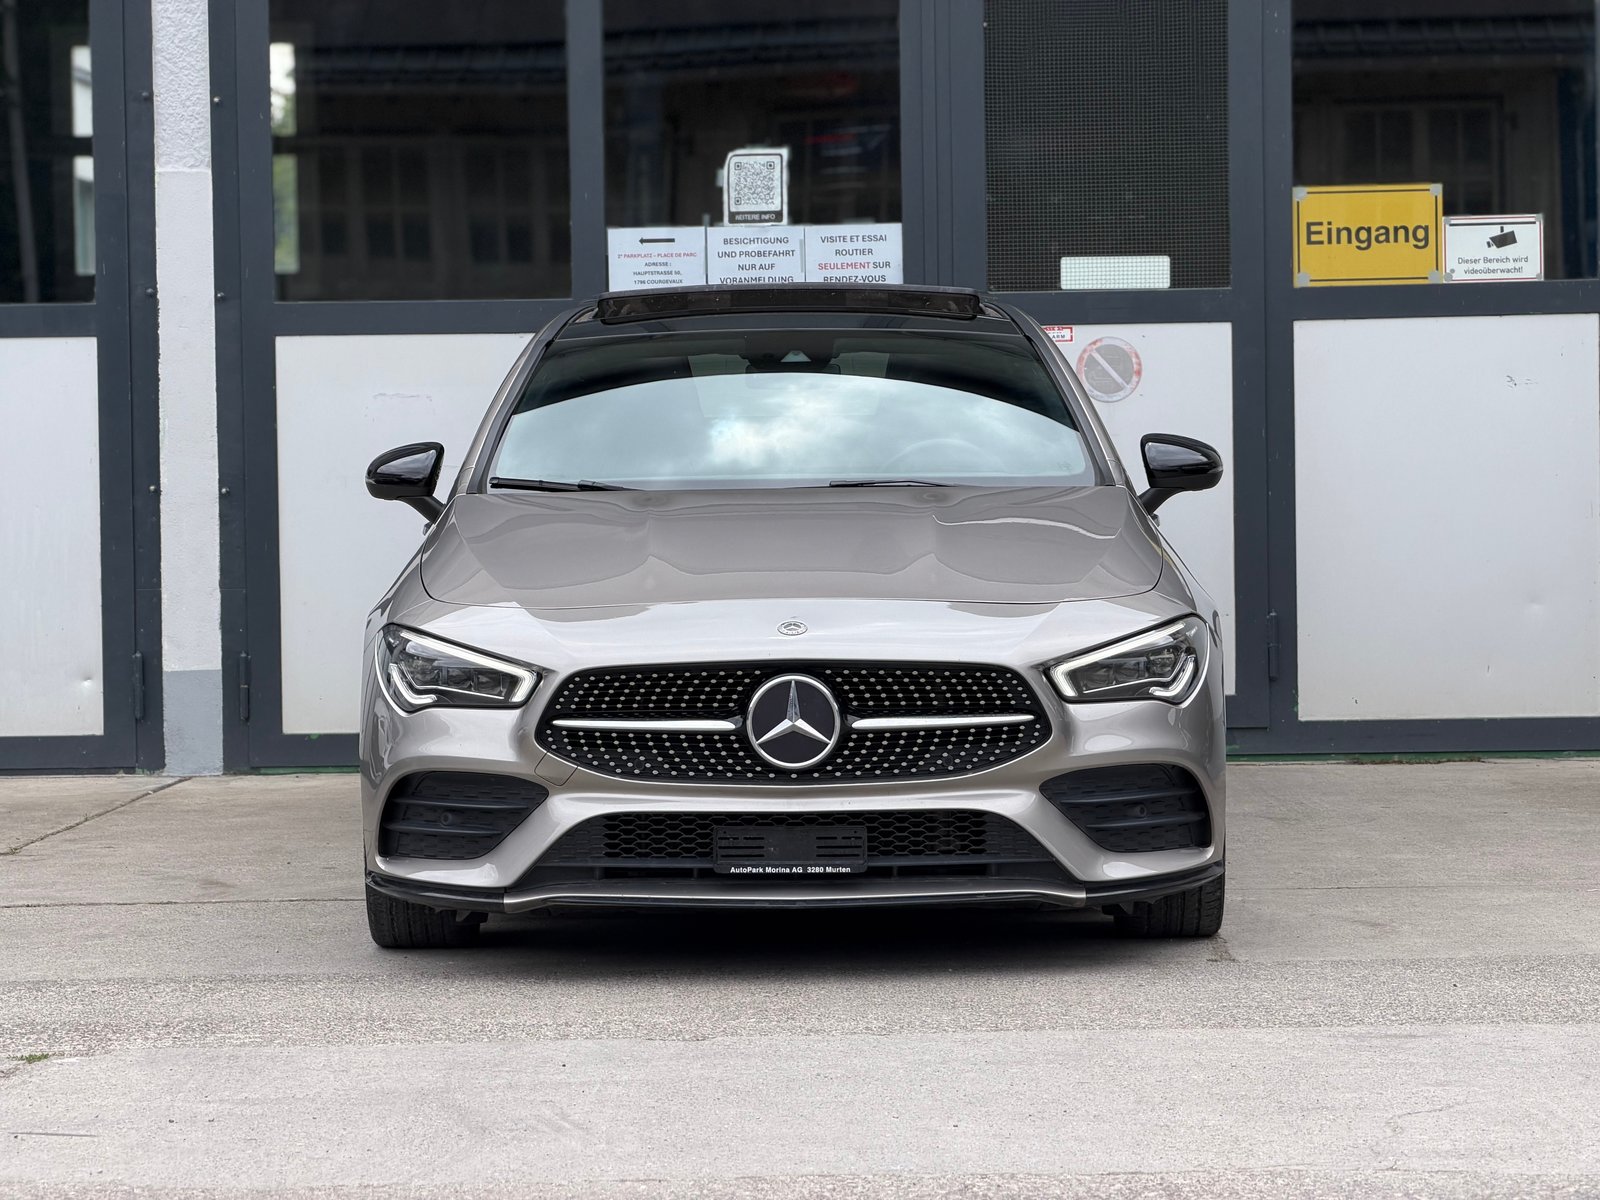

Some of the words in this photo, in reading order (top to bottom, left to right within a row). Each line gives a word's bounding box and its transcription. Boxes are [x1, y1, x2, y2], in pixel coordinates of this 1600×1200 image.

[820, 235, 848, 243] VISITE
[850, 235, 860, 243] ET
[862, 234, 887, 243] ESSAI
[1305, 221, 1430, 251] Eingang
[723, 236, 789, 246] BESICHTIGUNG
[717, 251, 737, 259] UND
[738, 249, 796, 258] PROBEFAHRT
[835, 248, 874, 257] ROUTIER
[1457, 256, 1482, 265] Dieser
[1483, 255, 1510, 264] Bereich
[1512, 255, 1529, 264] wird
[758, 263, 776, 271] AUF
[818, 261, 871, 271] SEULEMENT
[872, 261, 891, 269] SUR
[1463, 266, 1524, 275] videoüberwacht!
[719, 275, 794, 284] VORANMELDUNG
[823, 274, 887, 283] RENDEZ-VOUS
